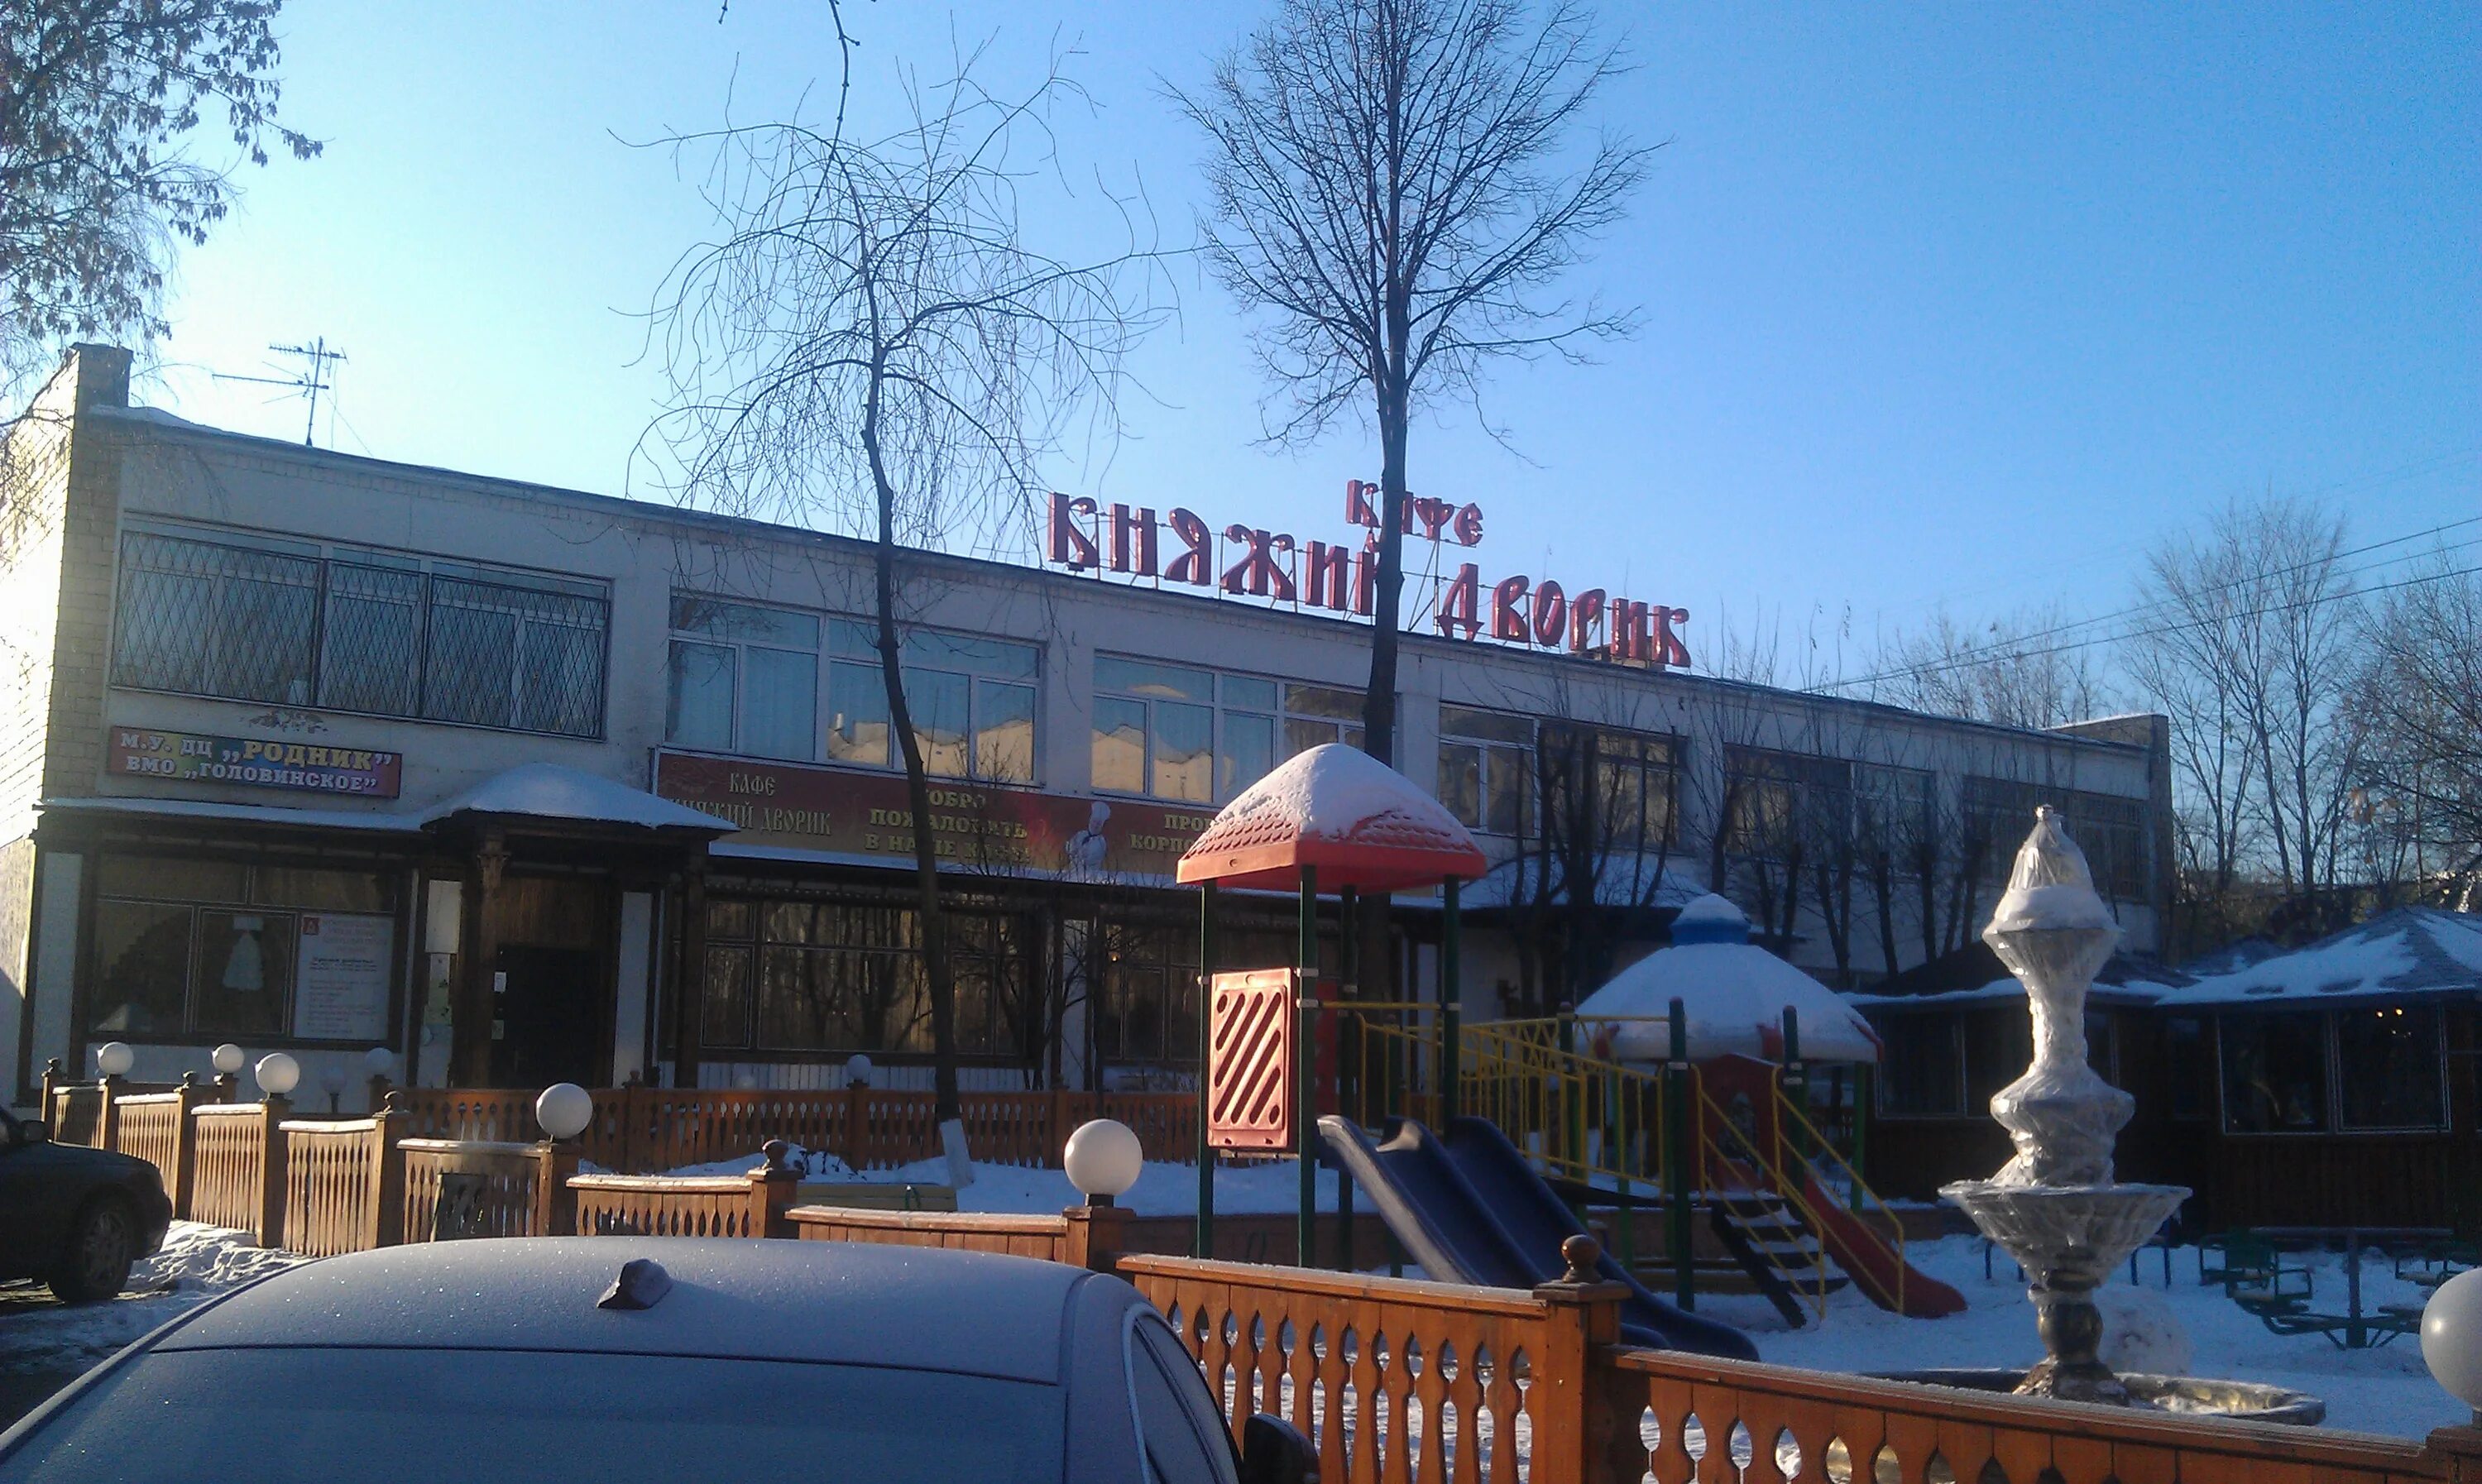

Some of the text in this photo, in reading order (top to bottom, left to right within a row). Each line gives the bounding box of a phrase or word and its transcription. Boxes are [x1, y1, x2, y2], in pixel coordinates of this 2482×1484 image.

[1435, 563, 1691, 668] ДВОРИК
[180, 739, 212, 759] ДЦ
[126, 756, 175, 774] ВМО
[729, 773, 776, 796] КАФЕ
[760, 807, 831, 836] ДВОРИК
[865, 834, 879, 850] В
